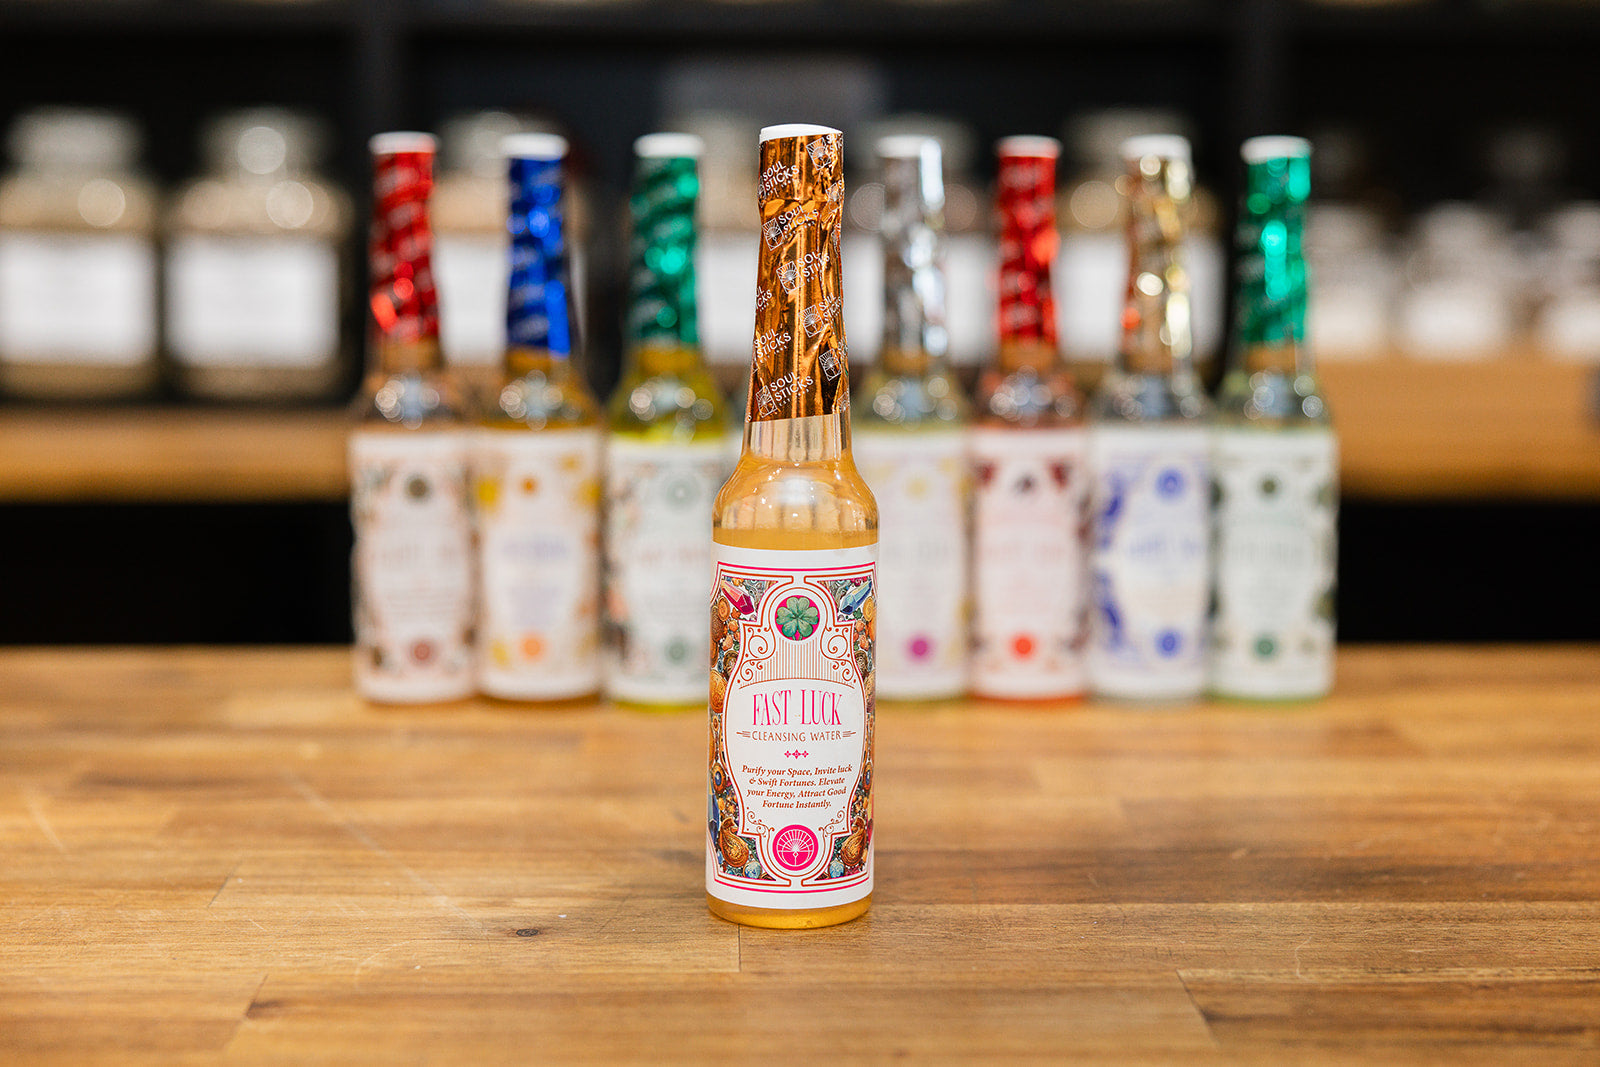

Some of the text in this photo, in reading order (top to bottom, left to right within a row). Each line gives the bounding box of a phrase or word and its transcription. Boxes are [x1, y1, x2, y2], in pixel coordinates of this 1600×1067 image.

[763, 161, 786, 182] SOUL
[765, 165, 800, 191] STICKS
[754, 329, 778, 348] SOUL
[757, 332, 791, 358] STICKS
[770, 372, 800, 392] SOUL
[775, 376, 814, 402] STICKS
[752, 689, 843, 726] FAST LUCK
[752, 730, 842, 742] CLEANSING WATER
[742, 763, 853, 778] Purify your Space, Invite luck
[757, 778, 778, 789] Swift
[819, 777, 846, 786] Elevate
[746, 786, 847, 800] your Energy, Attract Good
[762, 799, 832, 810] Fortune Instantly.
